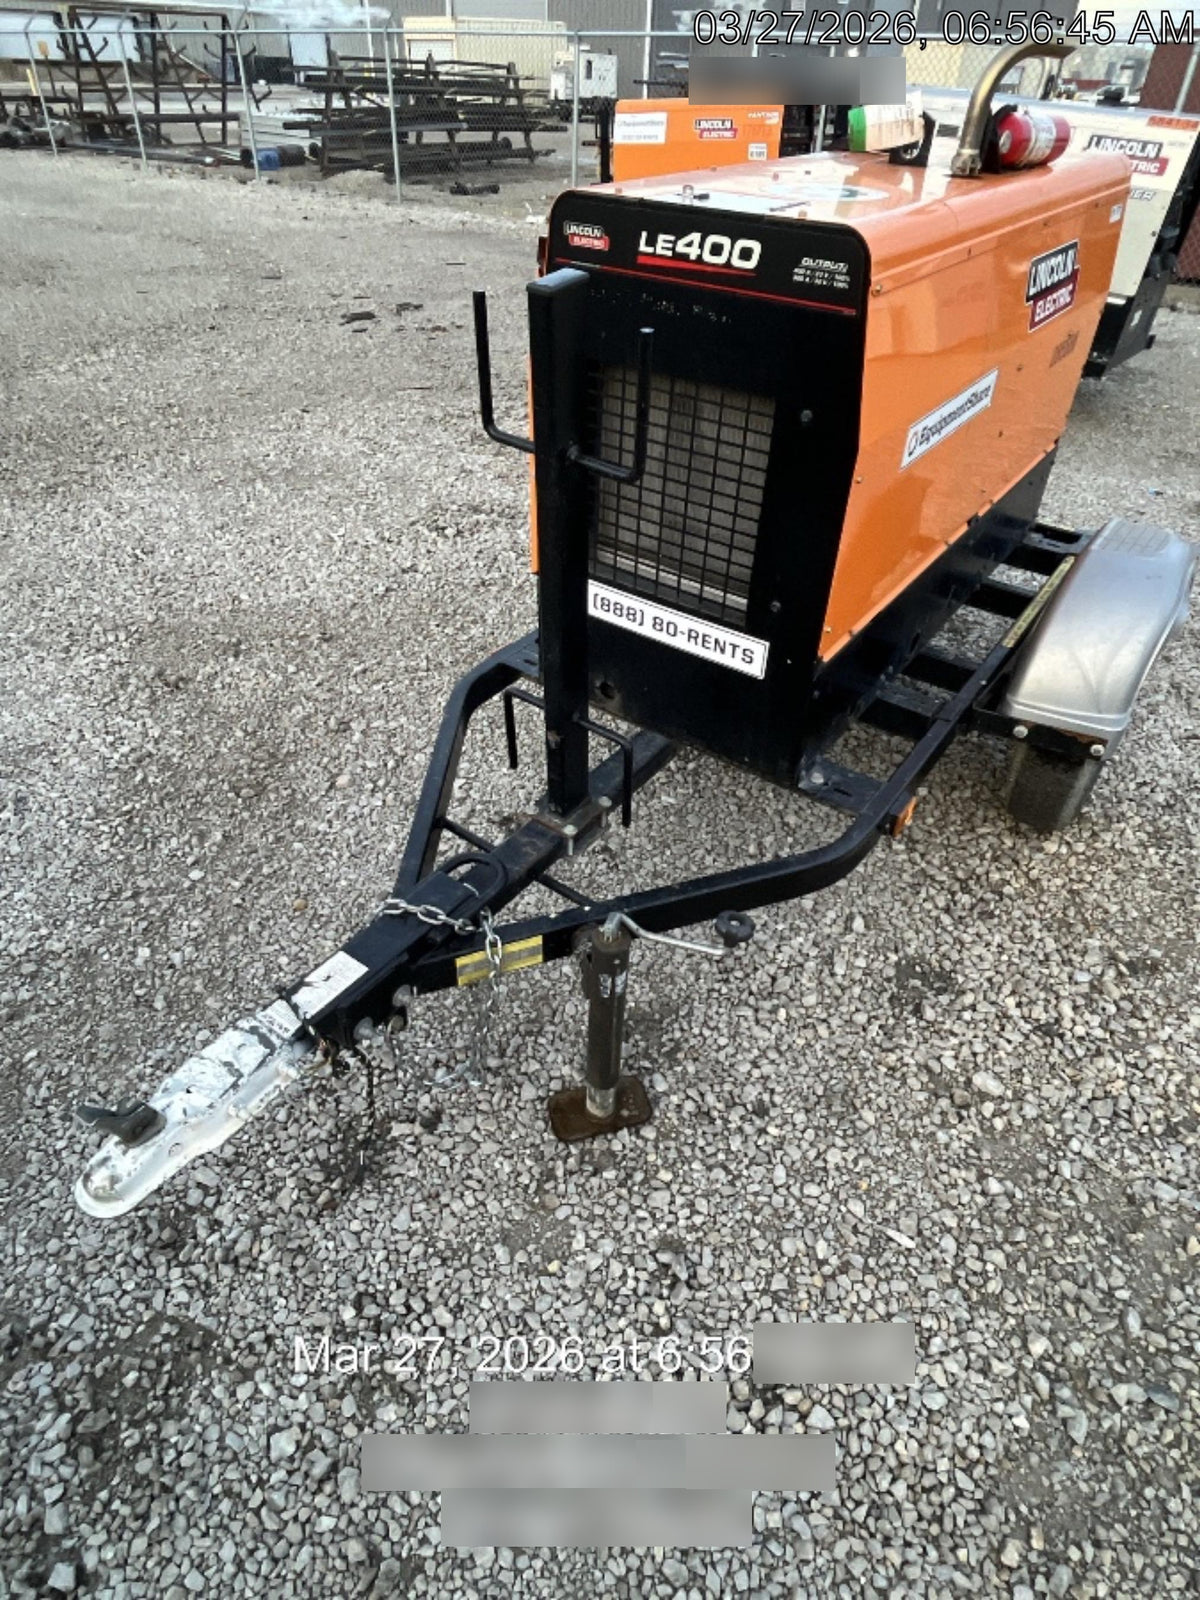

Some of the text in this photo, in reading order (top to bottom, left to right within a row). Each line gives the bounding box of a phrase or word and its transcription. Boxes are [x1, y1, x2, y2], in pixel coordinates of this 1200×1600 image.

[696, 119, 733, 131] LINCOLN
[702, 130, 735, 139] ELECTRIC
[1087, 136, 1160, 159] LINCOLN
[566, 223, 603, 238] LINCOLN
[638, 230, 762, 270] LE400
[1029, 247, 1076, 296] LINCOLN
[1034, 283, 1074, 323] ELECTRIC
[593, 592, 756, 666] (888) 80-RENTS
